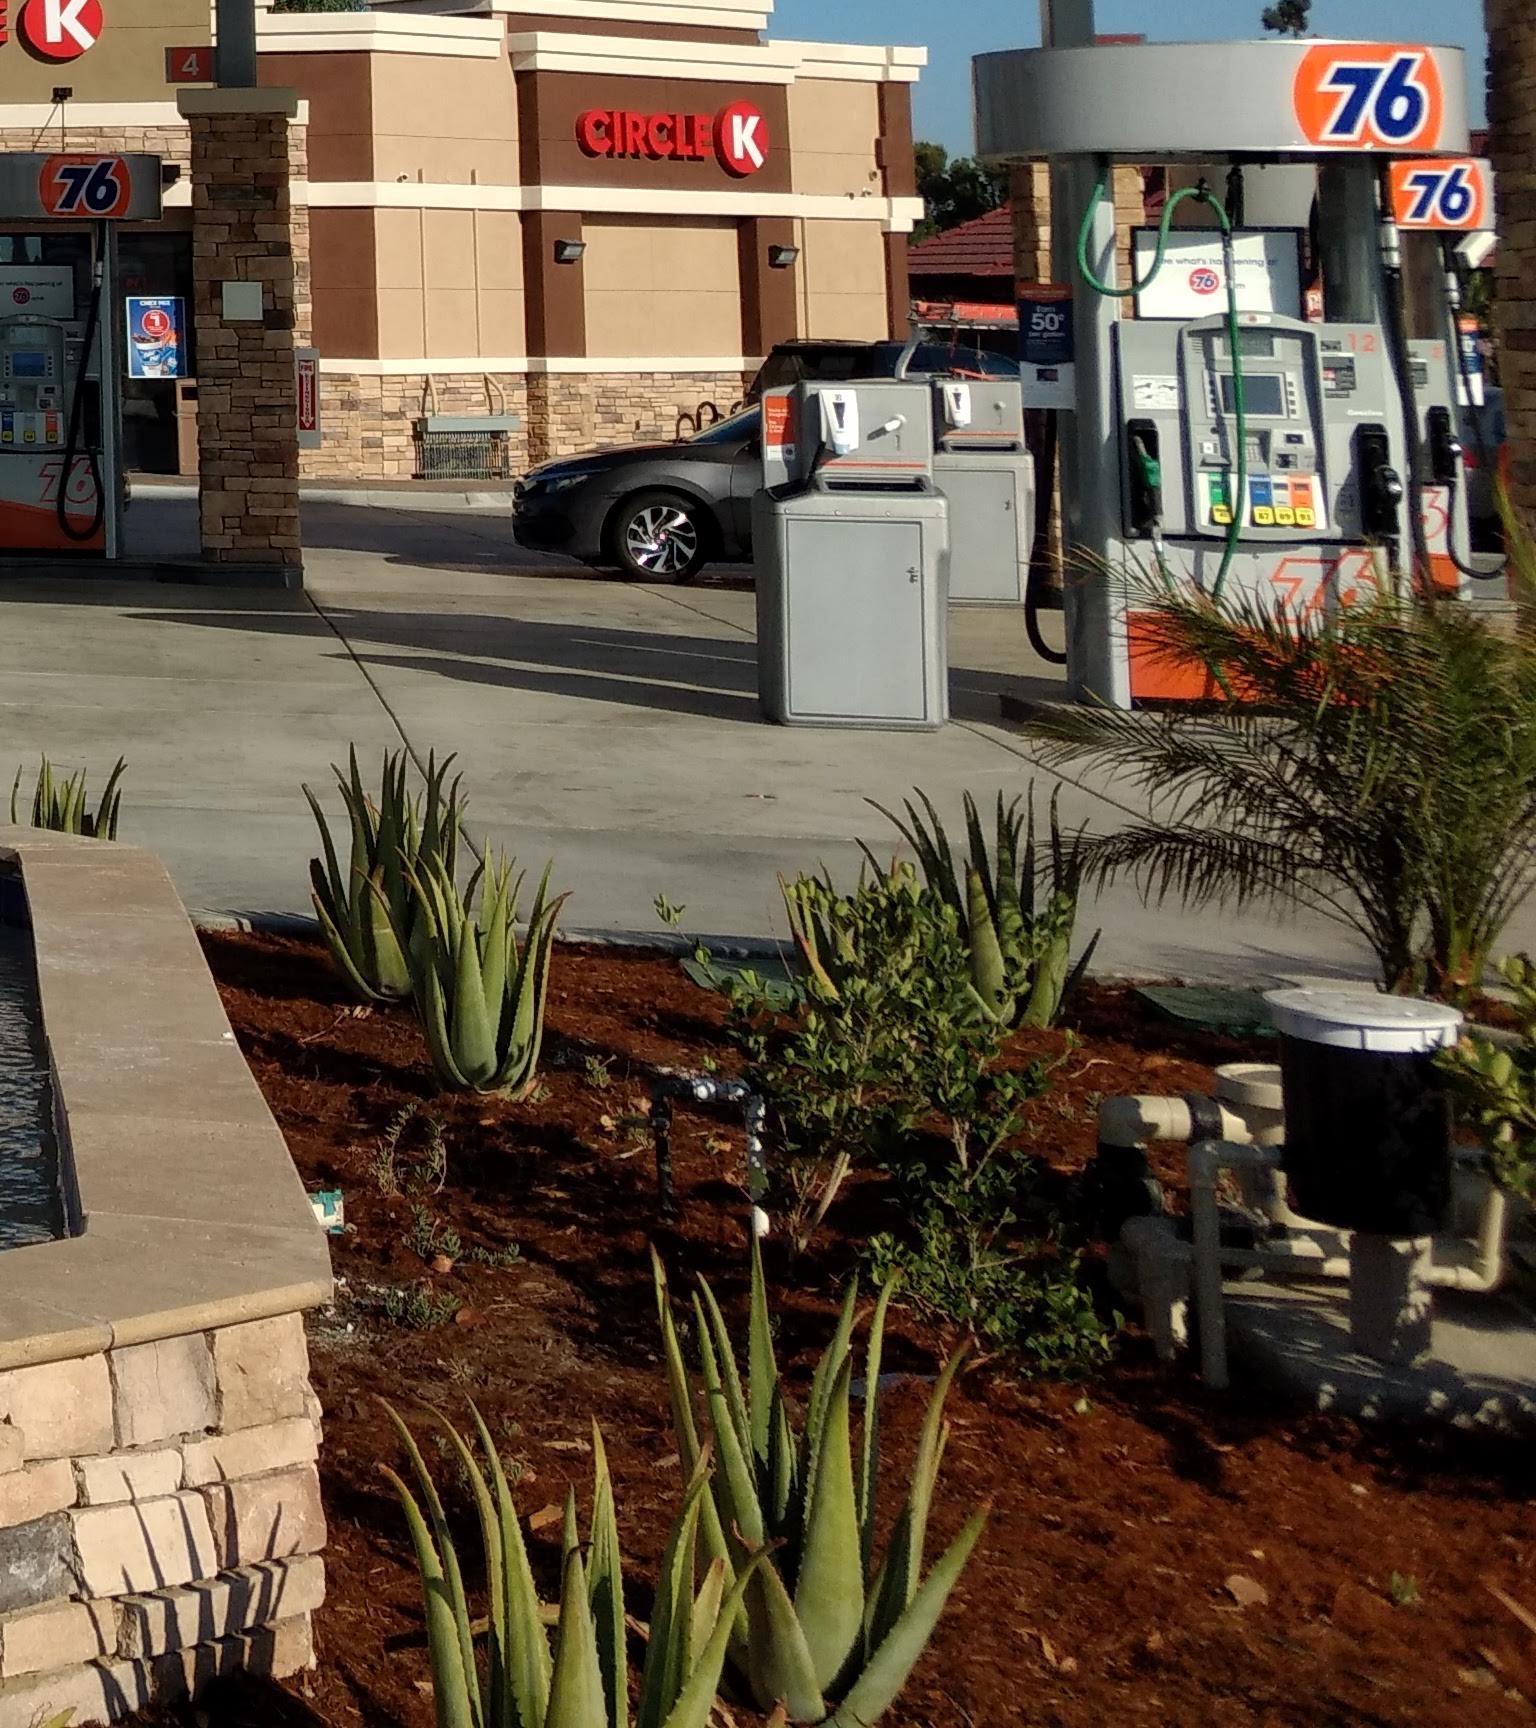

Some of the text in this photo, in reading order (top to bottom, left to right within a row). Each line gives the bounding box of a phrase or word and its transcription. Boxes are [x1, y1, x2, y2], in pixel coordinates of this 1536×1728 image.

[180, 52, 198, 76] 4
[1316, 51, 1430, 145] 76
[583, 107, 765, 169] CIRCLE K
[52, 158, 121, 215] 76
[1402, 163, 1477, 225] 76
[1347, 333, 1377, 353] 12
